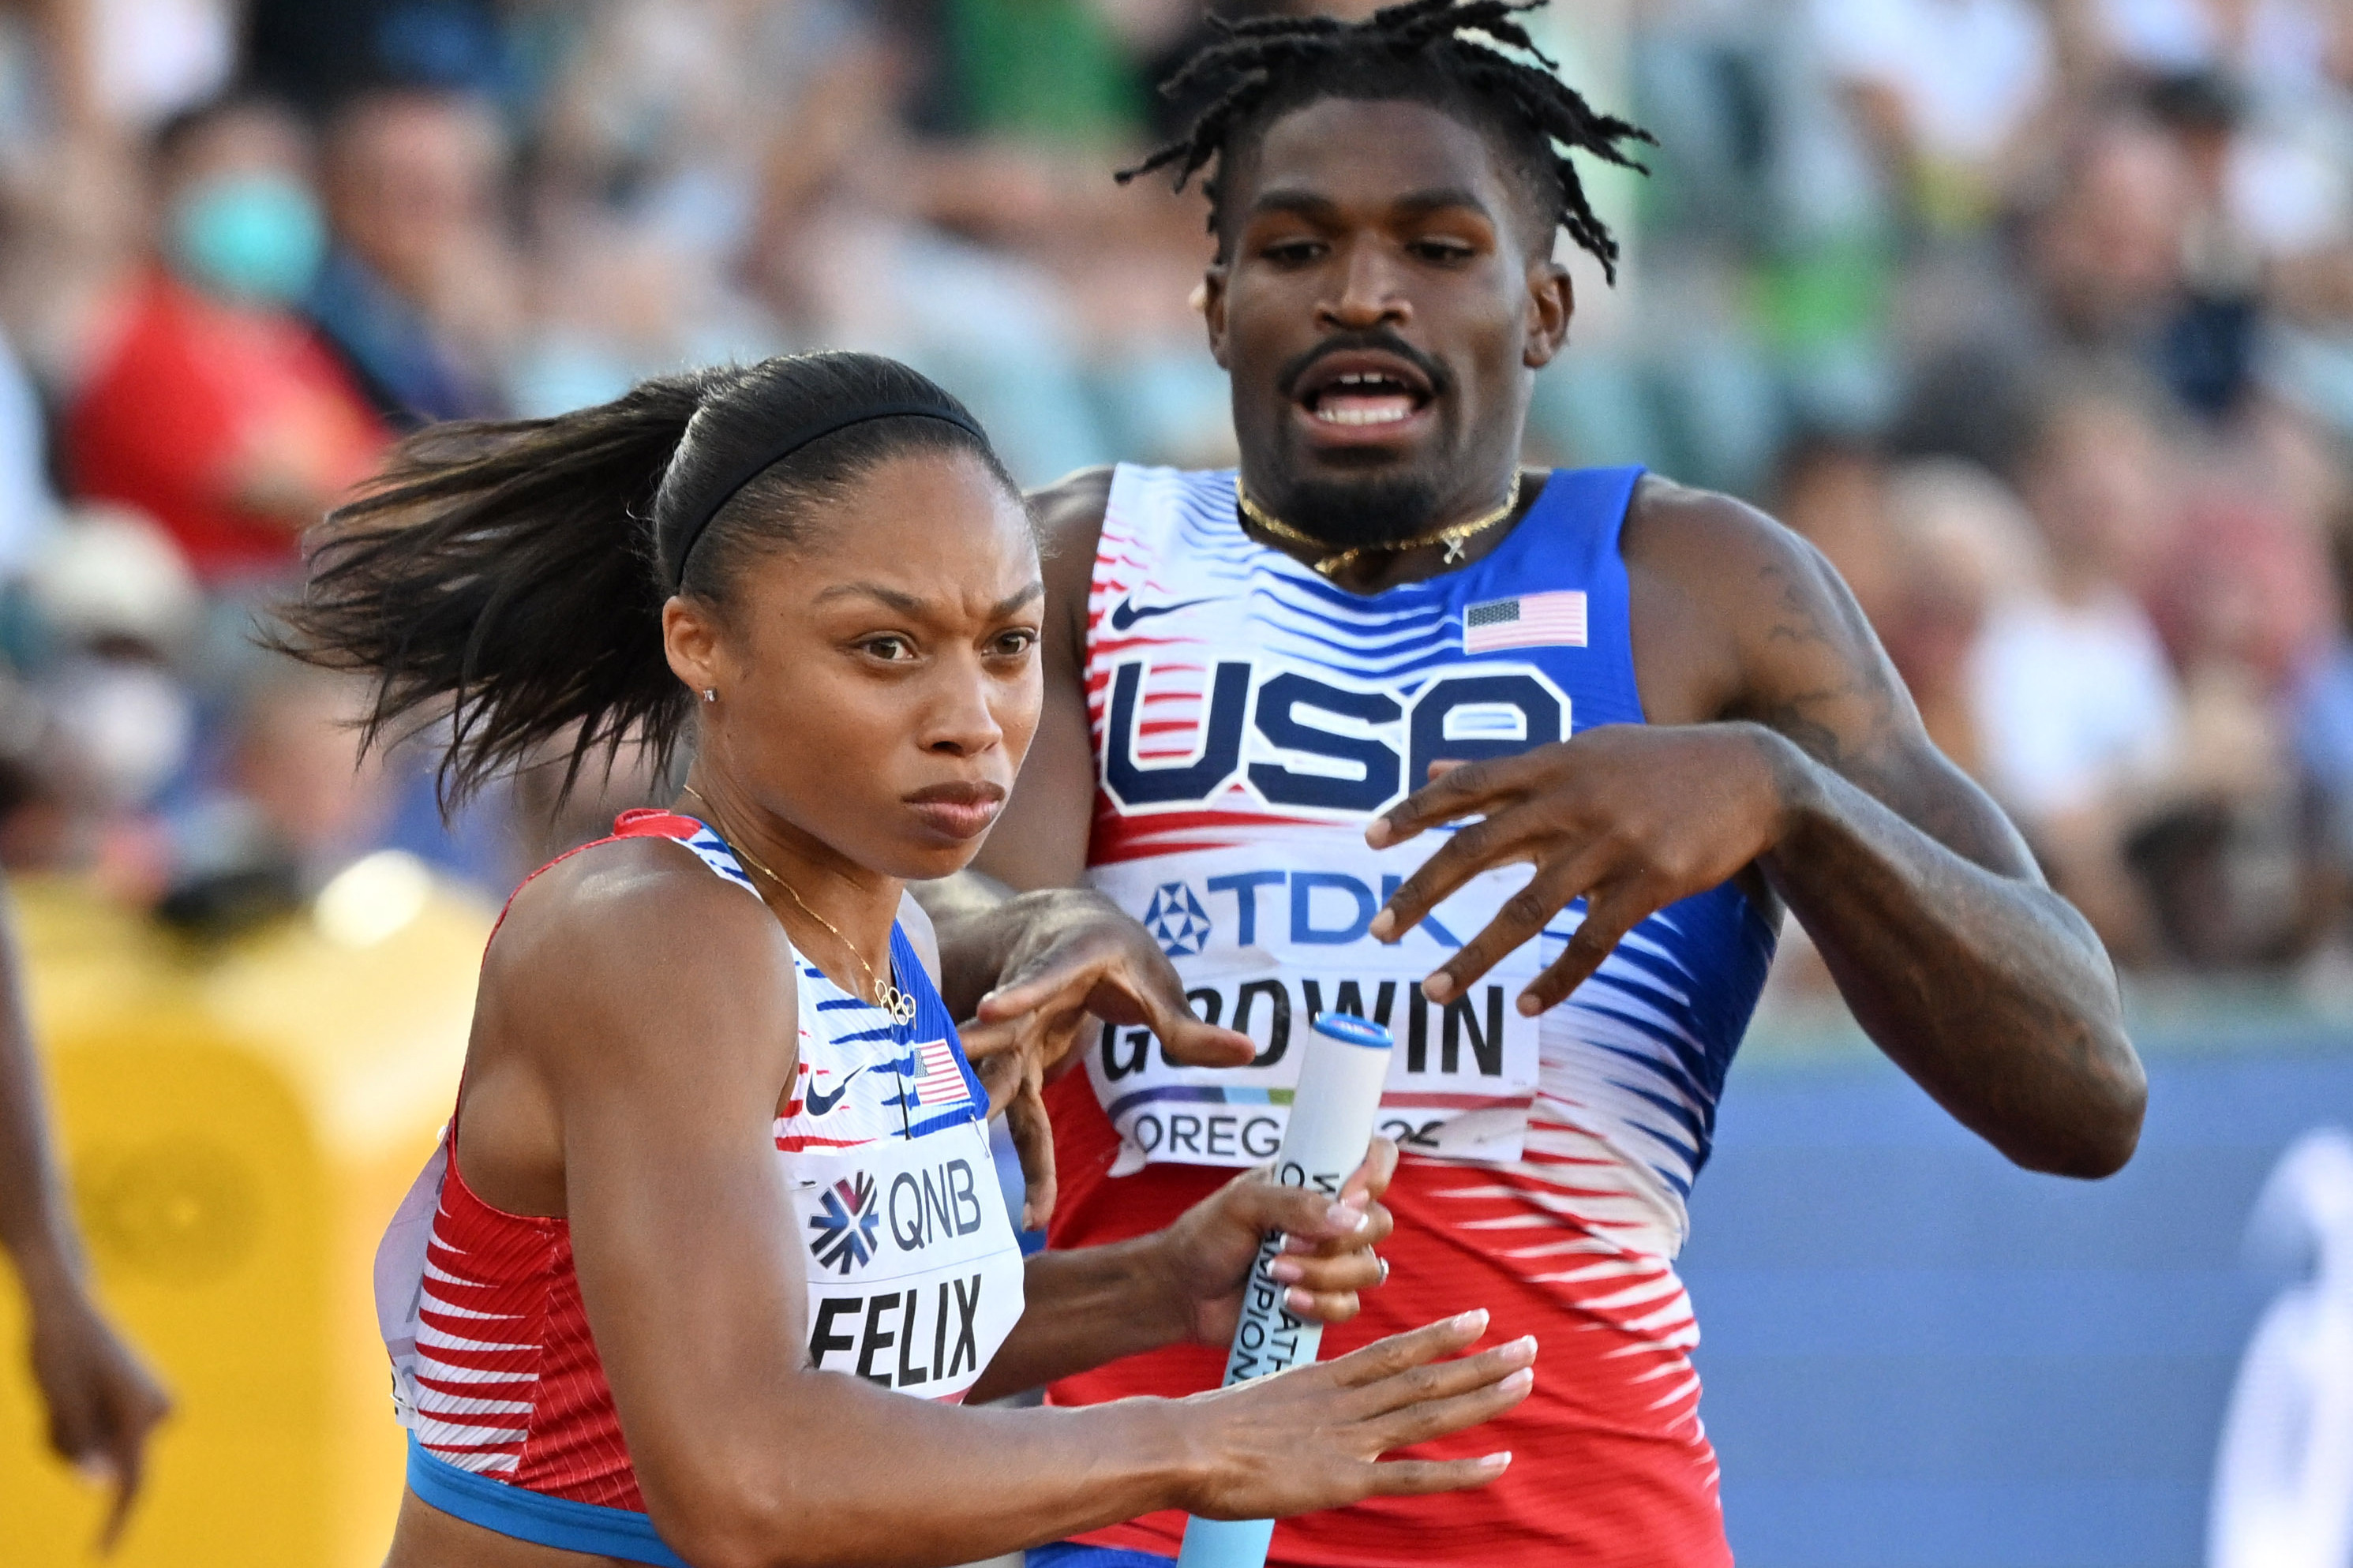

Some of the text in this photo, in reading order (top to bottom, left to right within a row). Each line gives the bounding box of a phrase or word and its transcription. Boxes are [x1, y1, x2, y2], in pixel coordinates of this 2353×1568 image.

[1102, 658, 1570, 814] USA
[889, 1158, 982, 1252] QNB
[809, 1273, 982, 1390] FELIX
